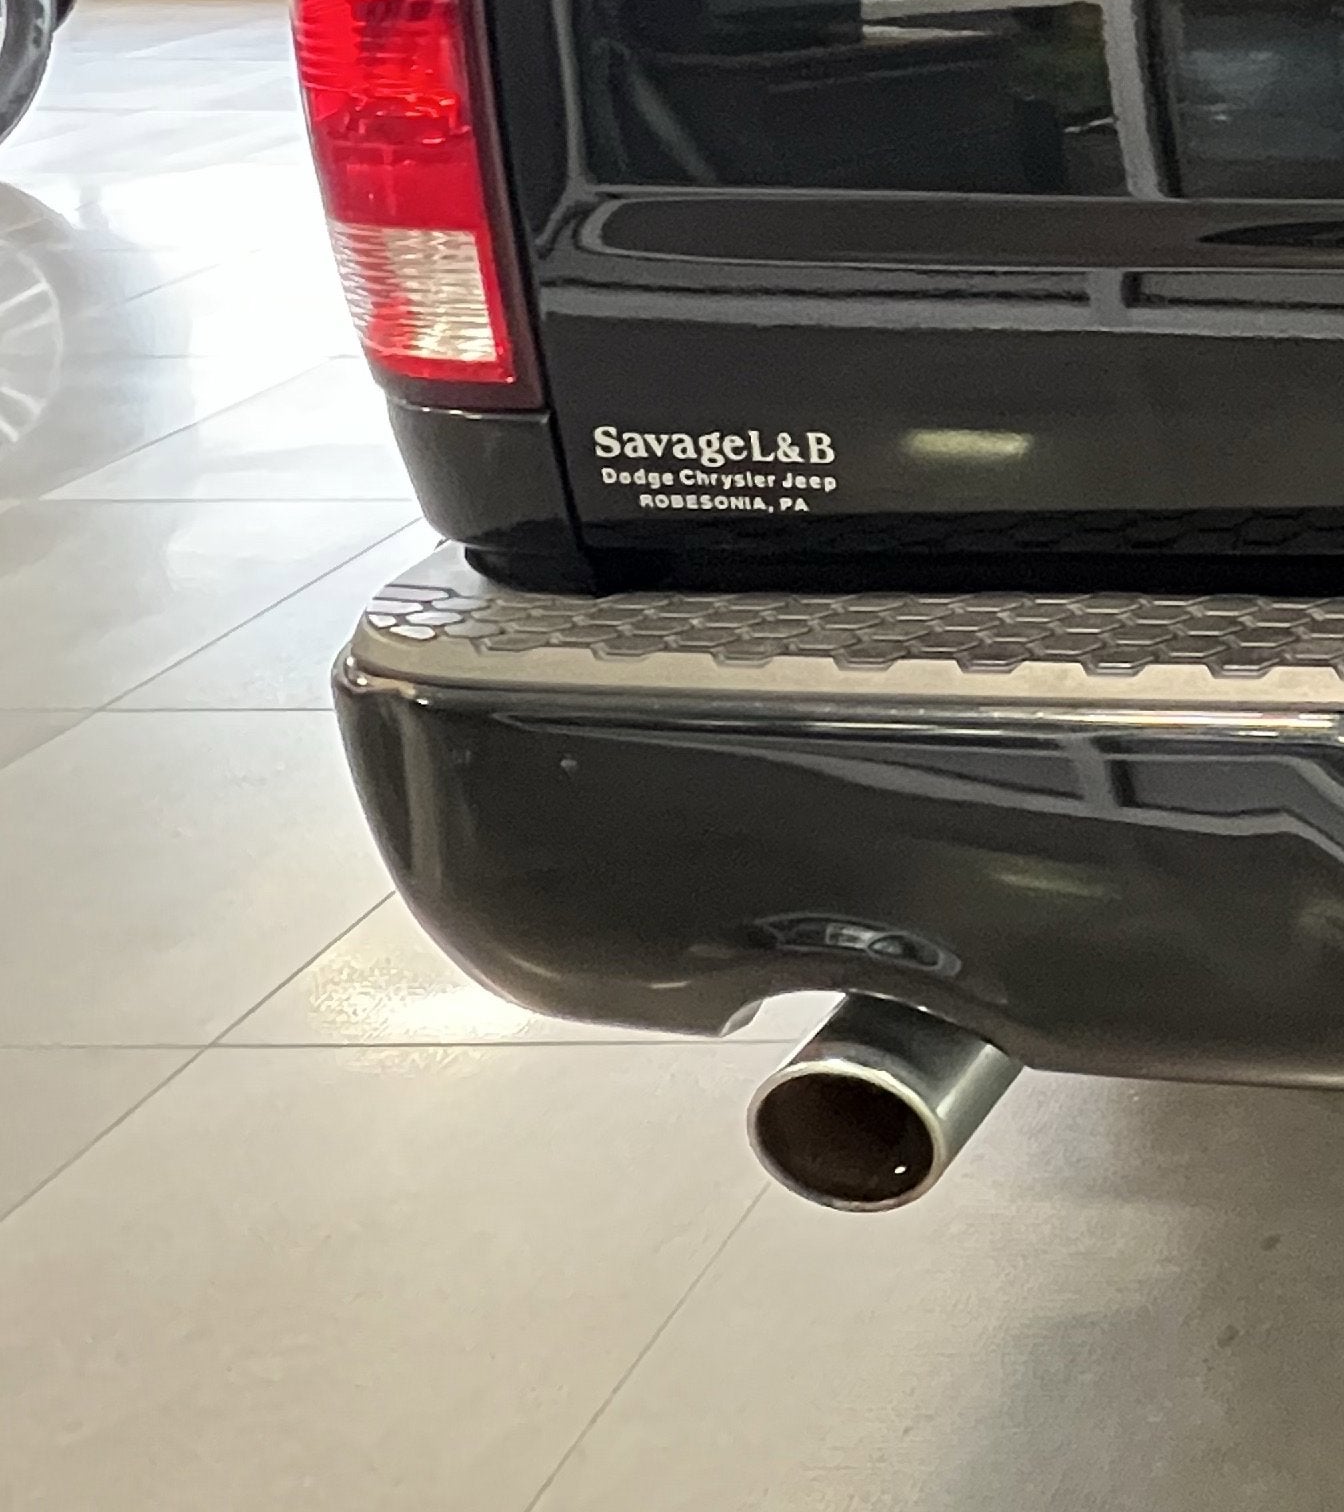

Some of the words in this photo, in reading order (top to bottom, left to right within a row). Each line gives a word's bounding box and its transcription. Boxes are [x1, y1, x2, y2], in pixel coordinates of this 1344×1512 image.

[601, 467, 675, 489] Dodge
[678, 468, 776, 490] Chrysler
[782, 472, 837, 493] Jeep
[639, 494, 774, 514] ROBESONIA,
[779, 496, 810, 513] PA
